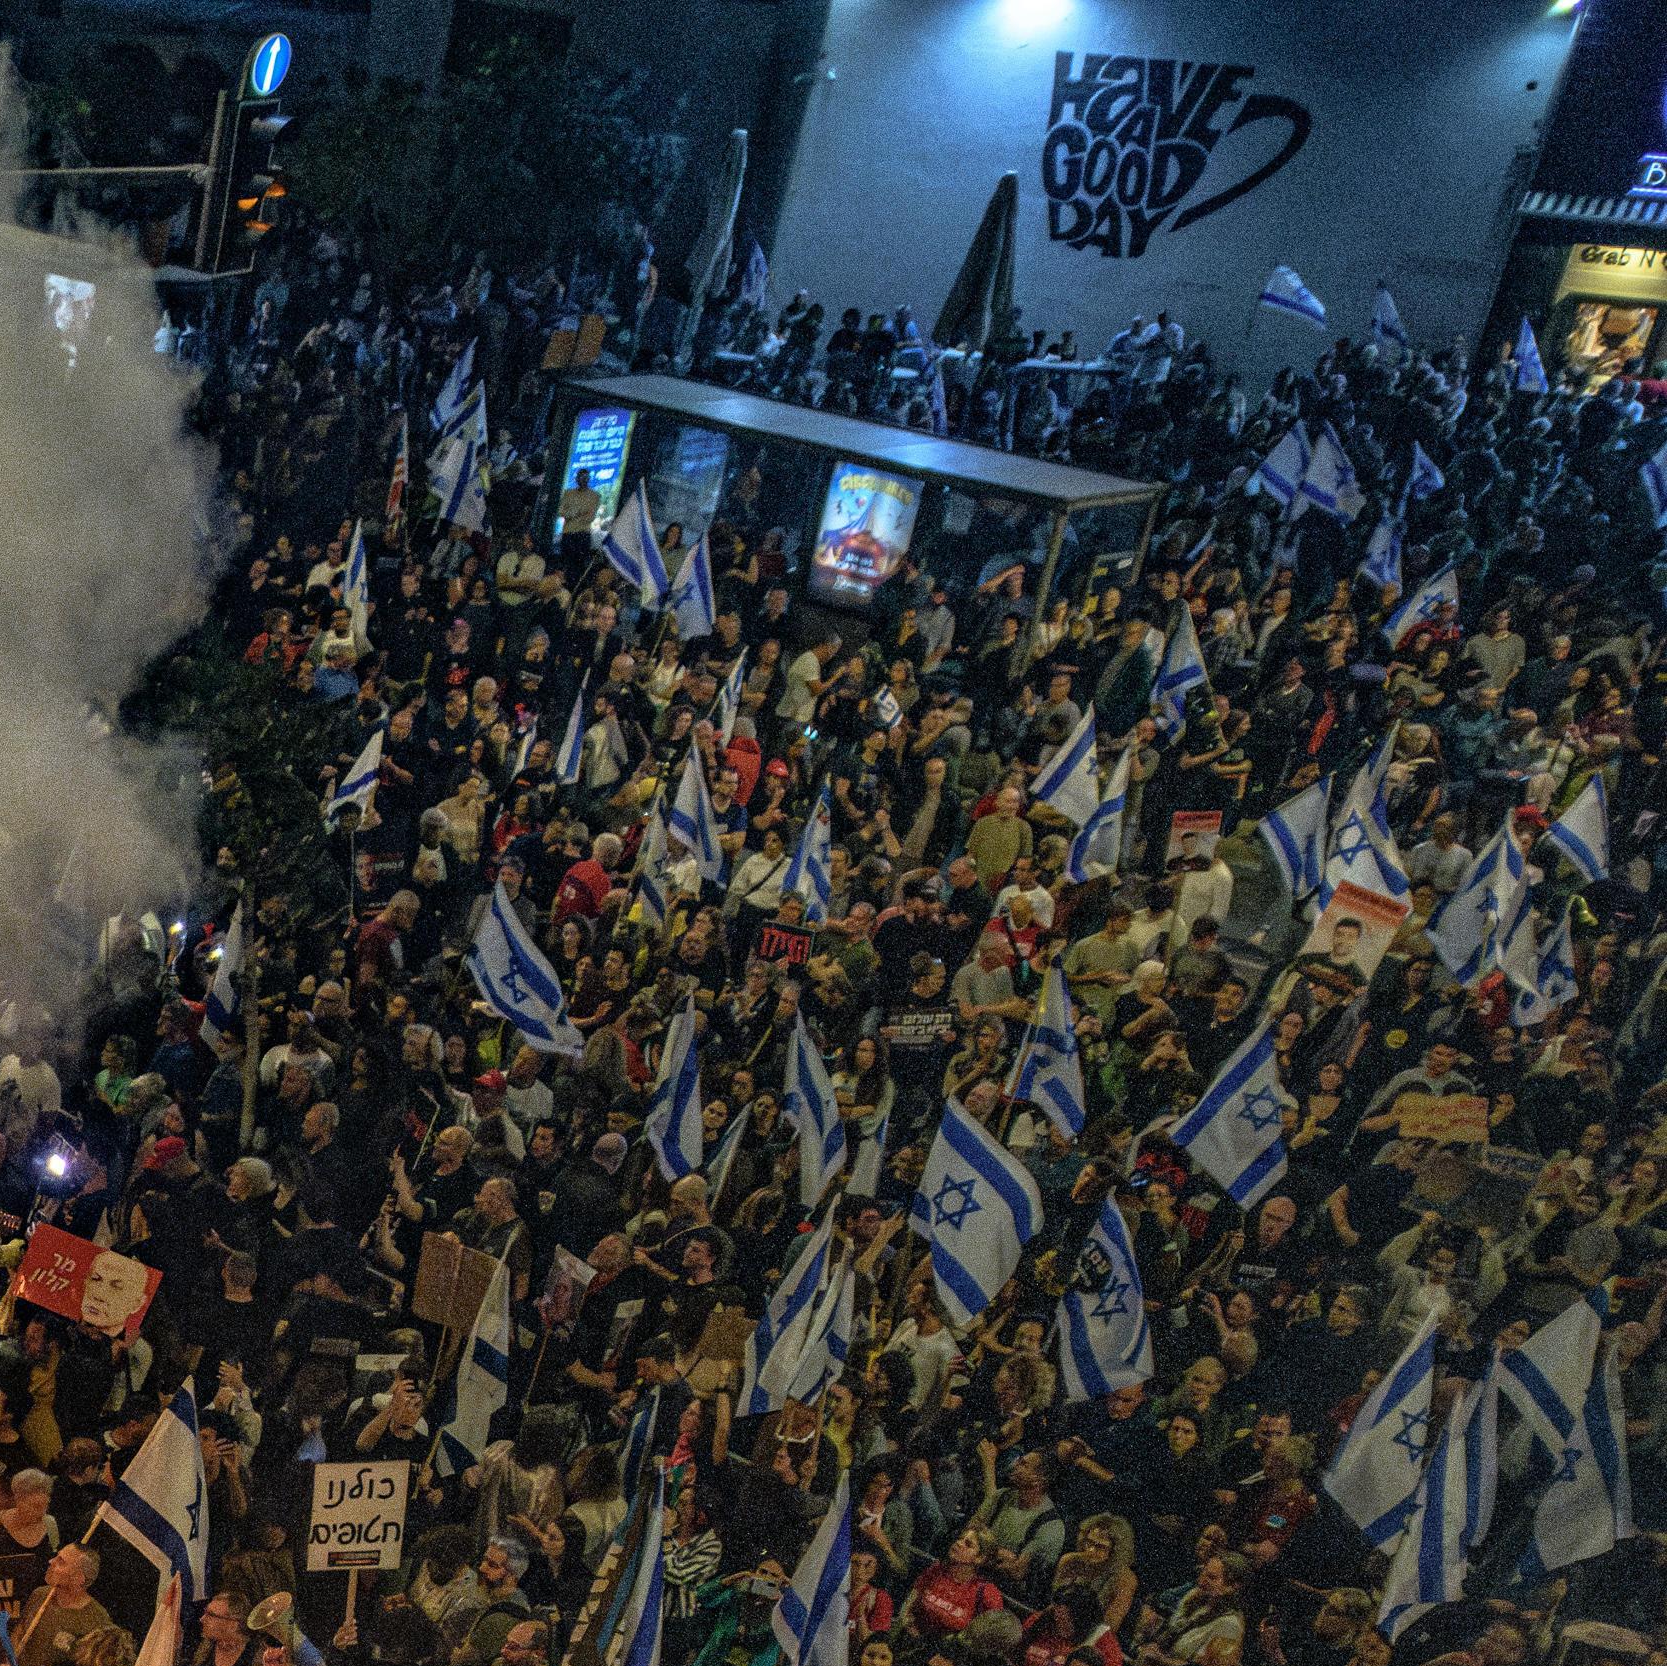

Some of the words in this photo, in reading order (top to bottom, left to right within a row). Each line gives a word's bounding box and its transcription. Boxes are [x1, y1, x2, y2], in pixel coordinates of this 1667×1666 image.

[1119, 103, 1160, 148] A
[1042, 122, 1208, 209] GOOD
[1049, 198, 1178, 258] DAY
[29, 1266, 70, 1293] קלון
[322, 1467, 396, 1510] כולנו
[308, 1513, 402, 1546] חטופים
